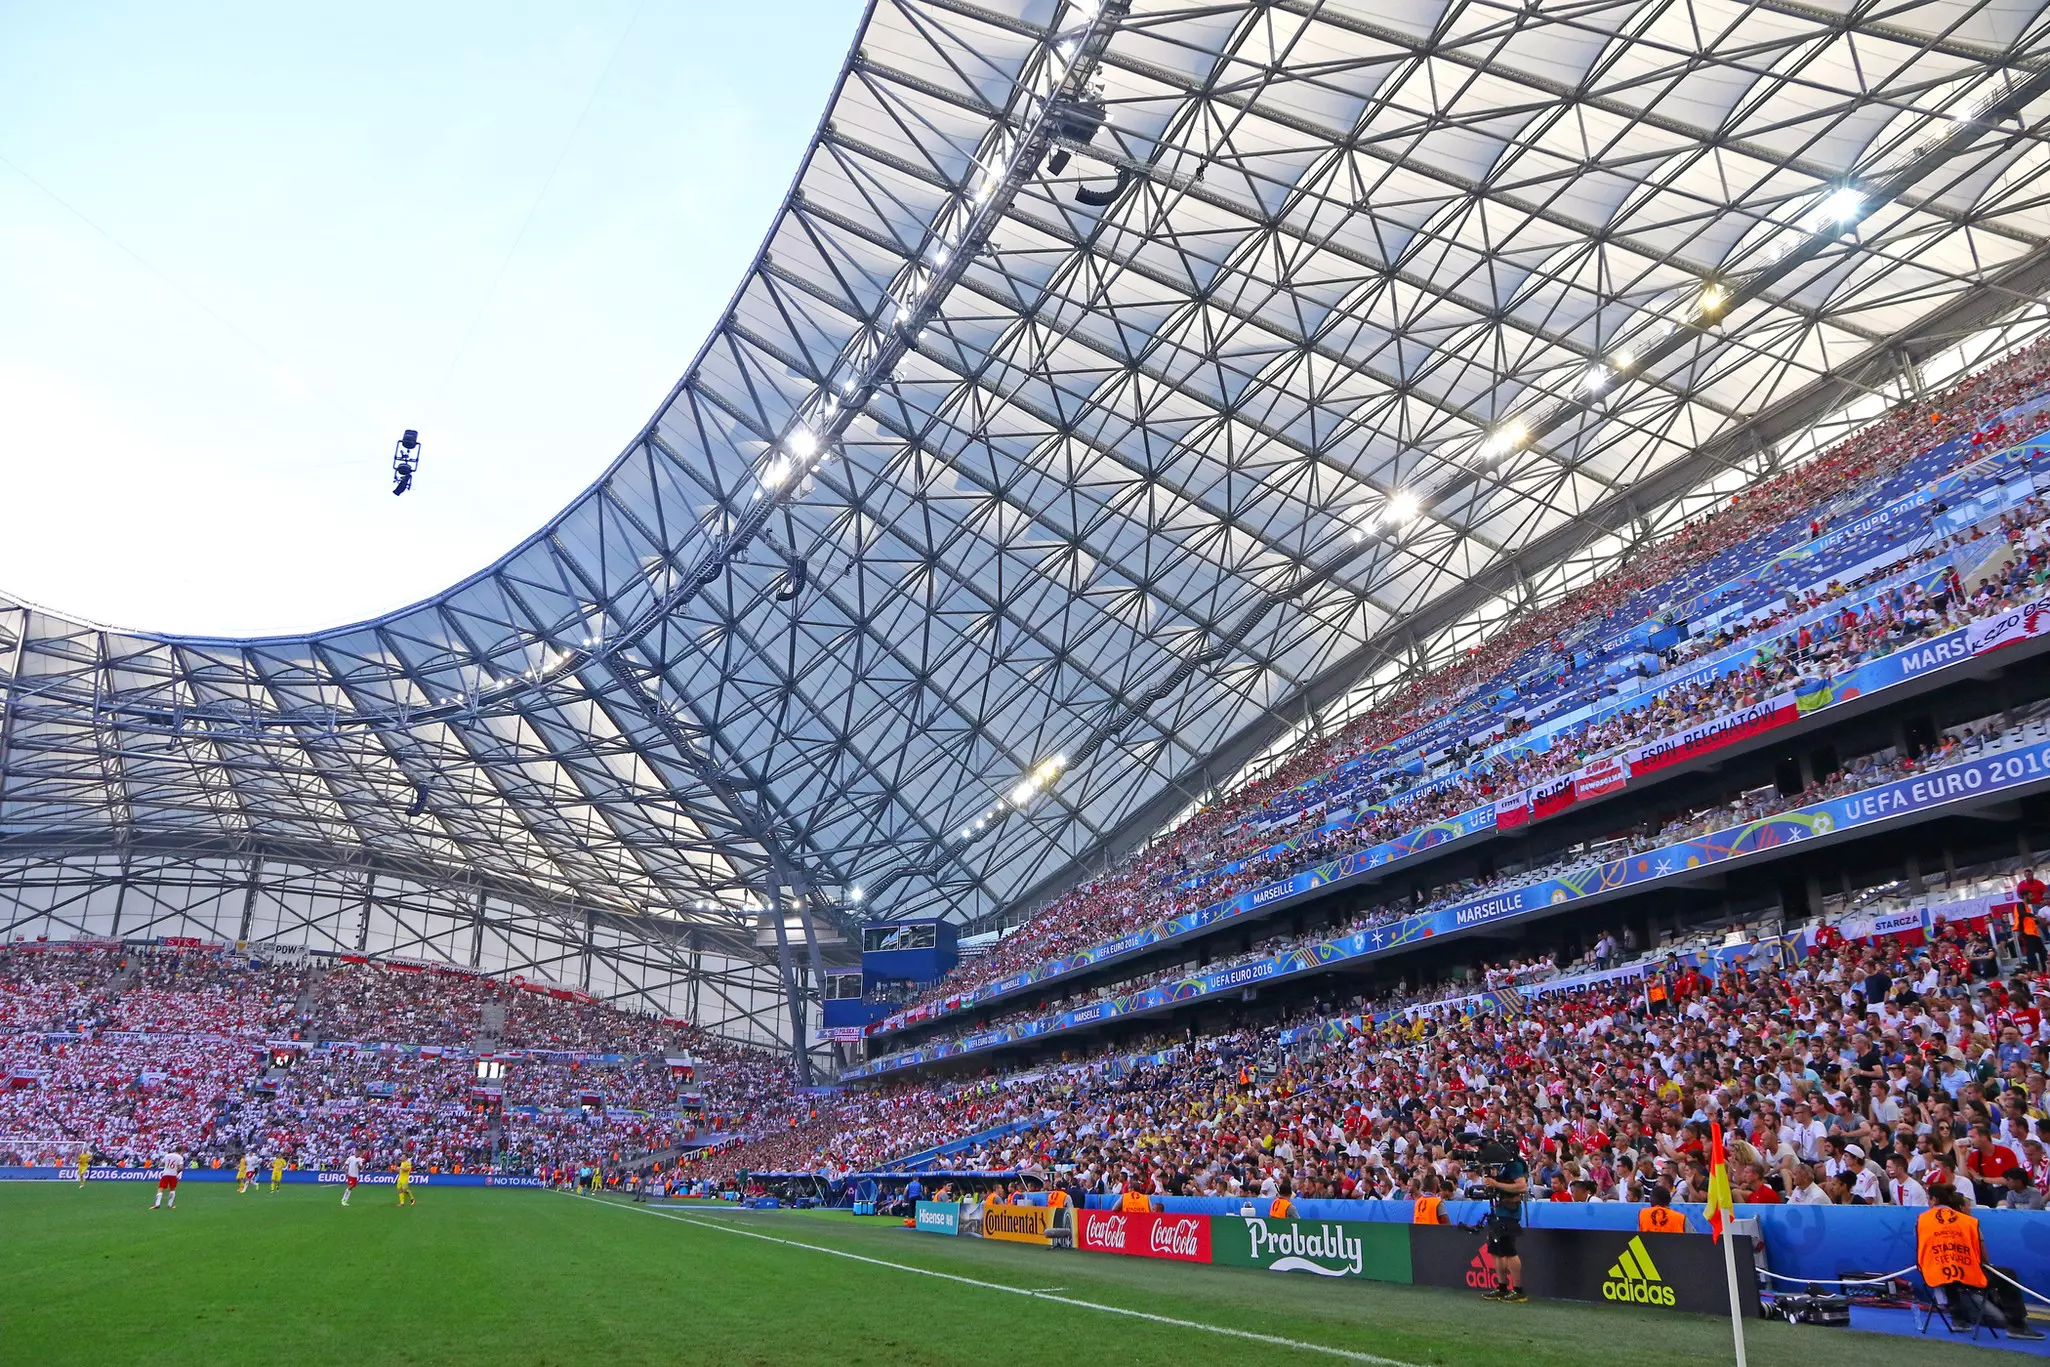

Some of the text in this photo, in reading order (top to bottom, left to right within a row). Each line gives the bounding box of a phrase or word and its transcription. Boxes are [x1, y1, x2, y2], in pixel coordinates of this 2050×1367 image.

[1971, 615, 2020, 652] KSZO
[1585, 633, 1631, 661] MSEILLE
[1641, 701, 1776, 767] ESPN BEŁCHATÓW
[1846, 789, 1908, 820] UEFA
[1912, 768, 1982, 803] EURO
[1253, 881, 1294, 905] MARSEILLE
[1456, 894, 1523, 924] MARSEILLE
[1875, 914, 1919, 931] STARCZA
[275, 945, 298, 955] PDW
[1096, 936, 1139, 958] UEFA EURO 2016
[1210, 962, 1273, 988] UEFA EURO 2016
[1074, 1008, 1100, 1023] MARSEILLE
[58, 1169, 183, 1180] EUO2016.com/MO
[167, 1158, 175, 1169] 16
[318, 1172, 430, 1184] EURO16.com/OTM
[494, 1177, 541, 1187] NO TO RACI
[919, 1208, 945, 1225] Hisense
[985, 1209, 1038, 1236] Continental
[1086, 1213, 1128, 1249] Coca-Cola
[1150, 1217, 1200, 1256] Coca-Cola
[1244, 1218, 1363, 1275] Probably
[1602, 1277, 1676, 1306] adidas
